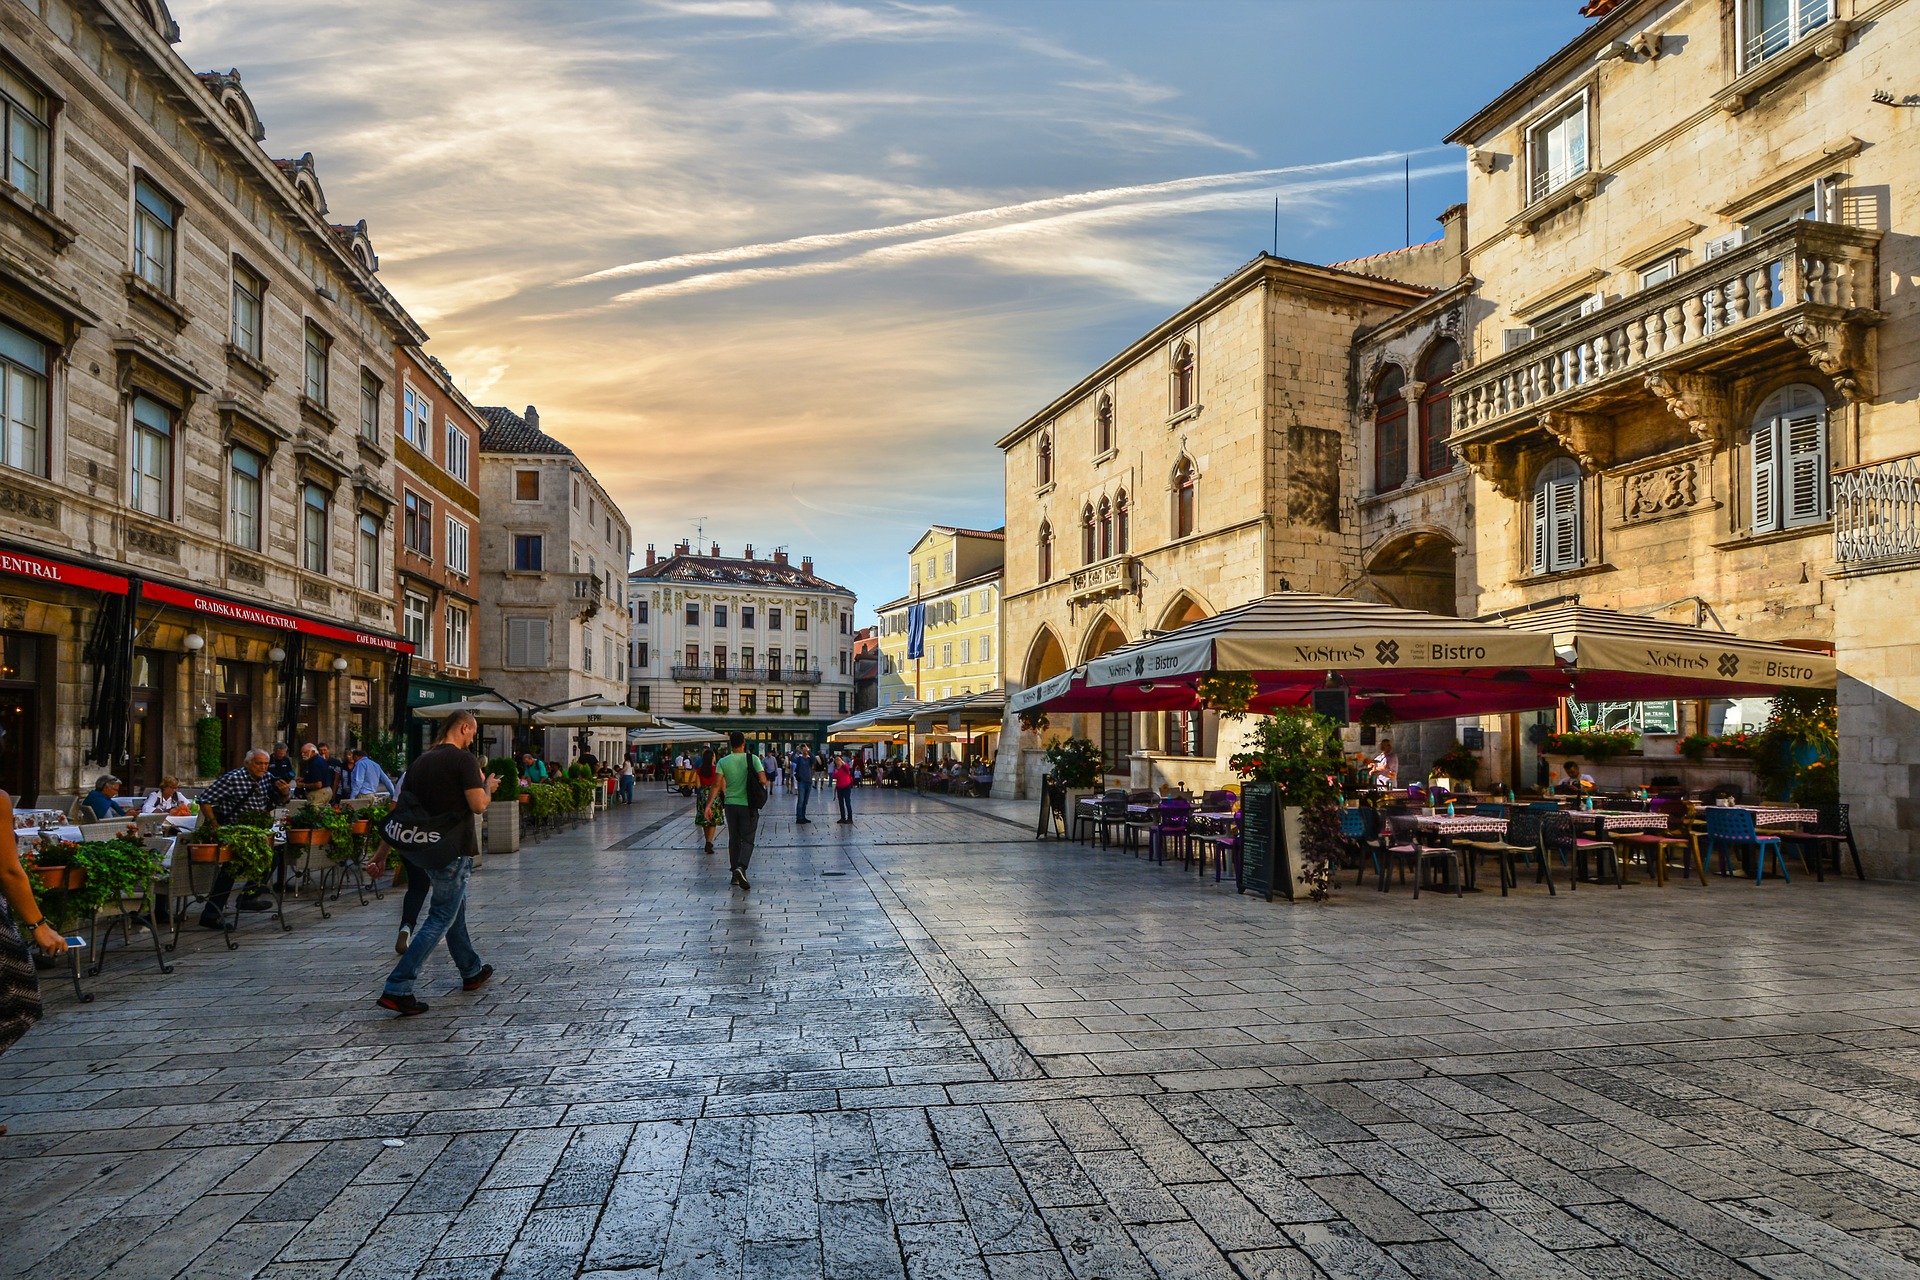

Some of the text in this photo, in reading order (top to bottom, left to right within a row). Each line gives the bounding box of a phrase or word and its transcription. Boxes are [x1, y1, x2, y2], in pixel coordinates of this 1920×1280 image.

[0, 555, 61, 580] ENTRAL
[194, 598, 298, 629] GRADSKA KAVANA CENTRAL
[369, 637, 377, 645] DE
[377, 638, 384, 647] LA
[383, 640, 397, 649] VILLE
[1432, 643, 1486, 660] Bistro
[1155, 655, 1178, 671] Bistro
[1766, 661, 1813, 680] Bistro
